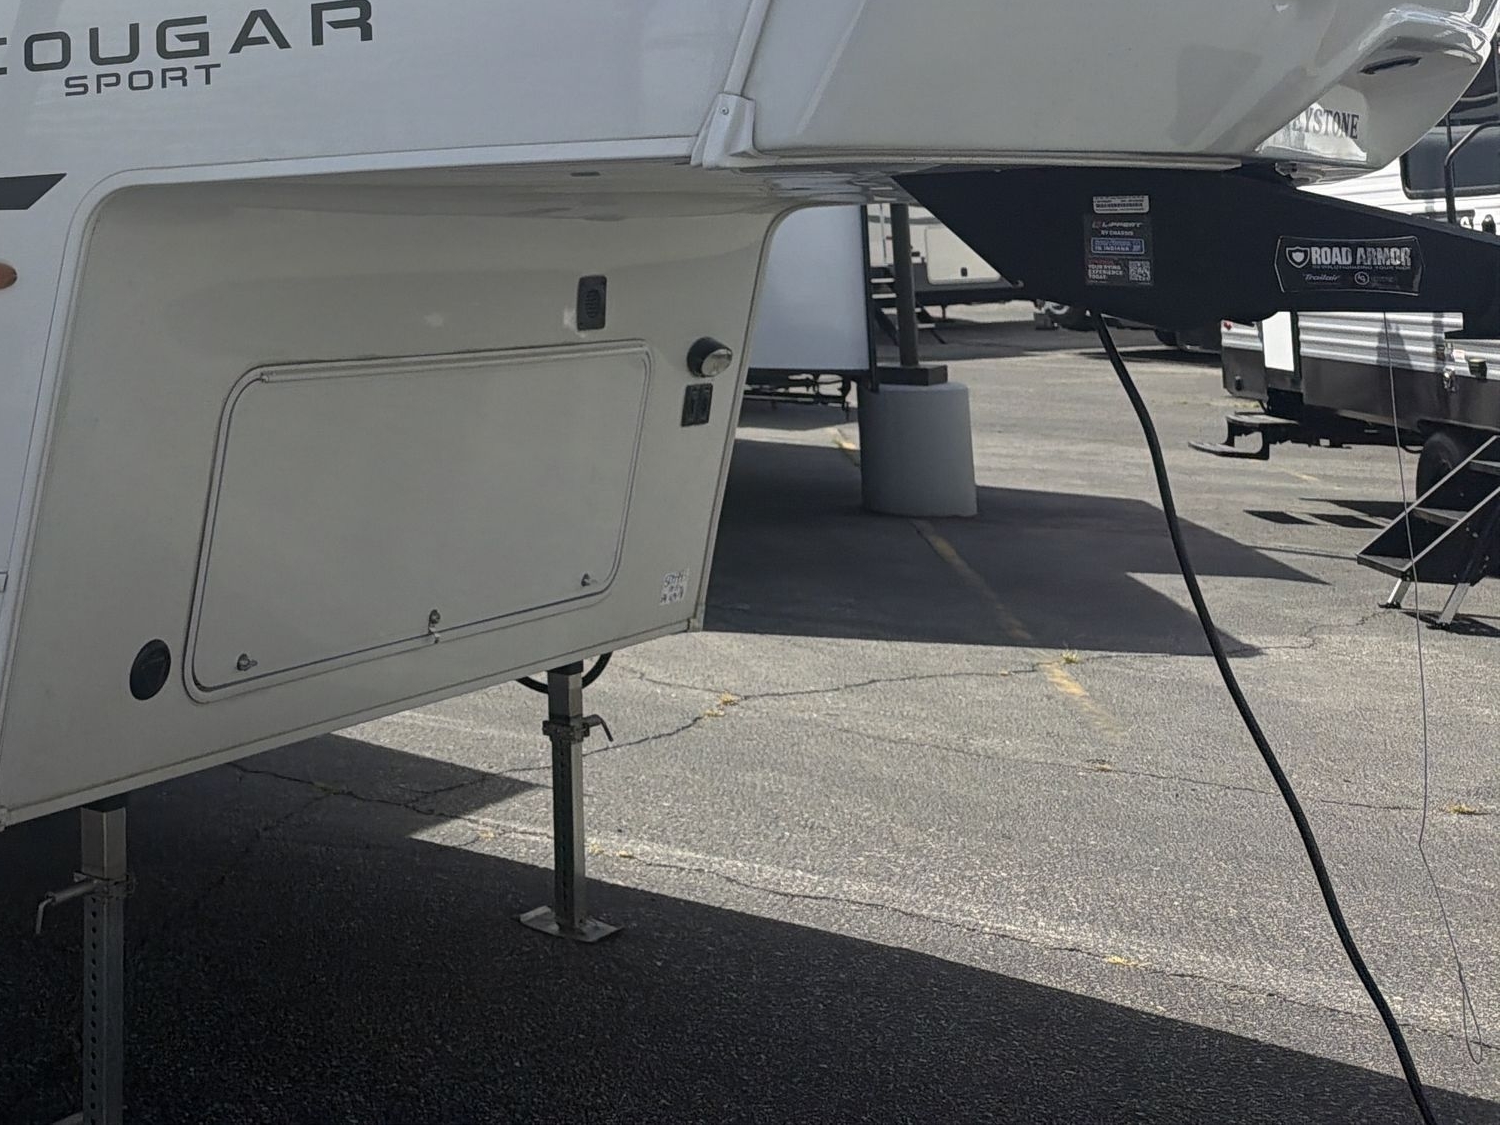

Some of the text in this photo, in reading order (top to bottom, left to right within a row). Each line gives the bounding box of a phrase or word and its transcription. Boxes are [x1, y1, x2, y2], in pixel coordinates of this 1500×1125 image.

[64, 63, 222, 97] SPORT
[1311, 246, 1411, 267] ROAD ARMOR
